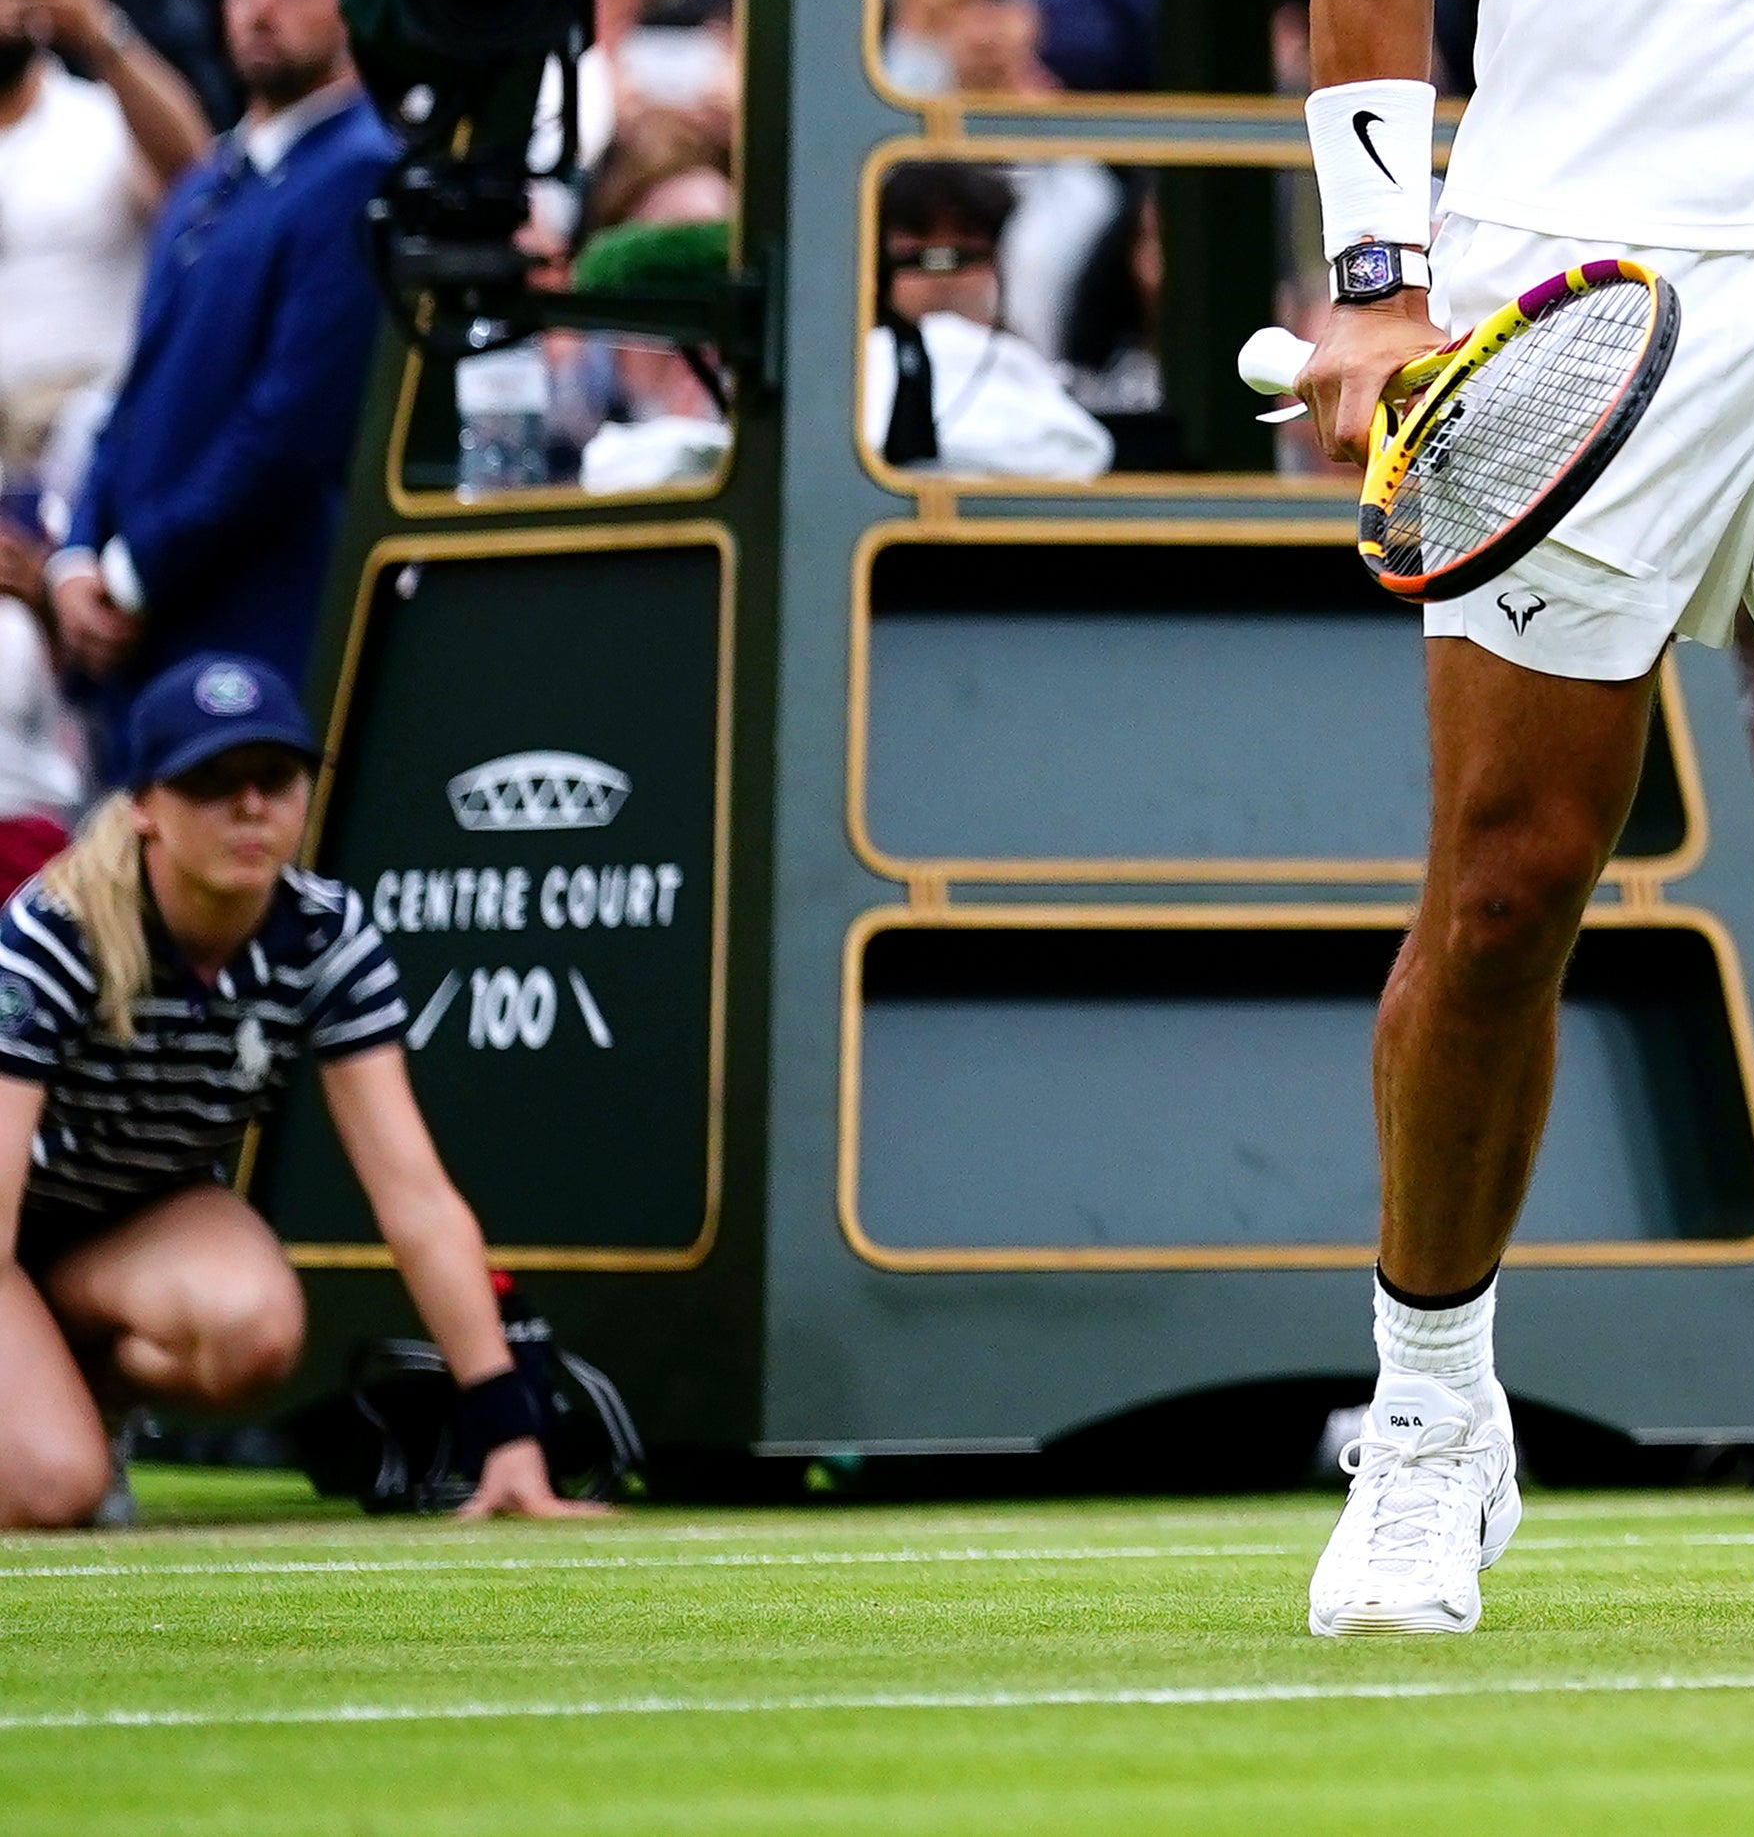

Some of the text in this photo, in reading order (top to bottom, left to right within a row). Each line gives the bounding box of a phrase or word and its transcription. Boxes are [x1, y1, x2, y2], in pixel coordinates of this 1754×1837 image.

[373, 864, 683, 932] CENTRE COURT
[468, 966, 558, 1050] 100
